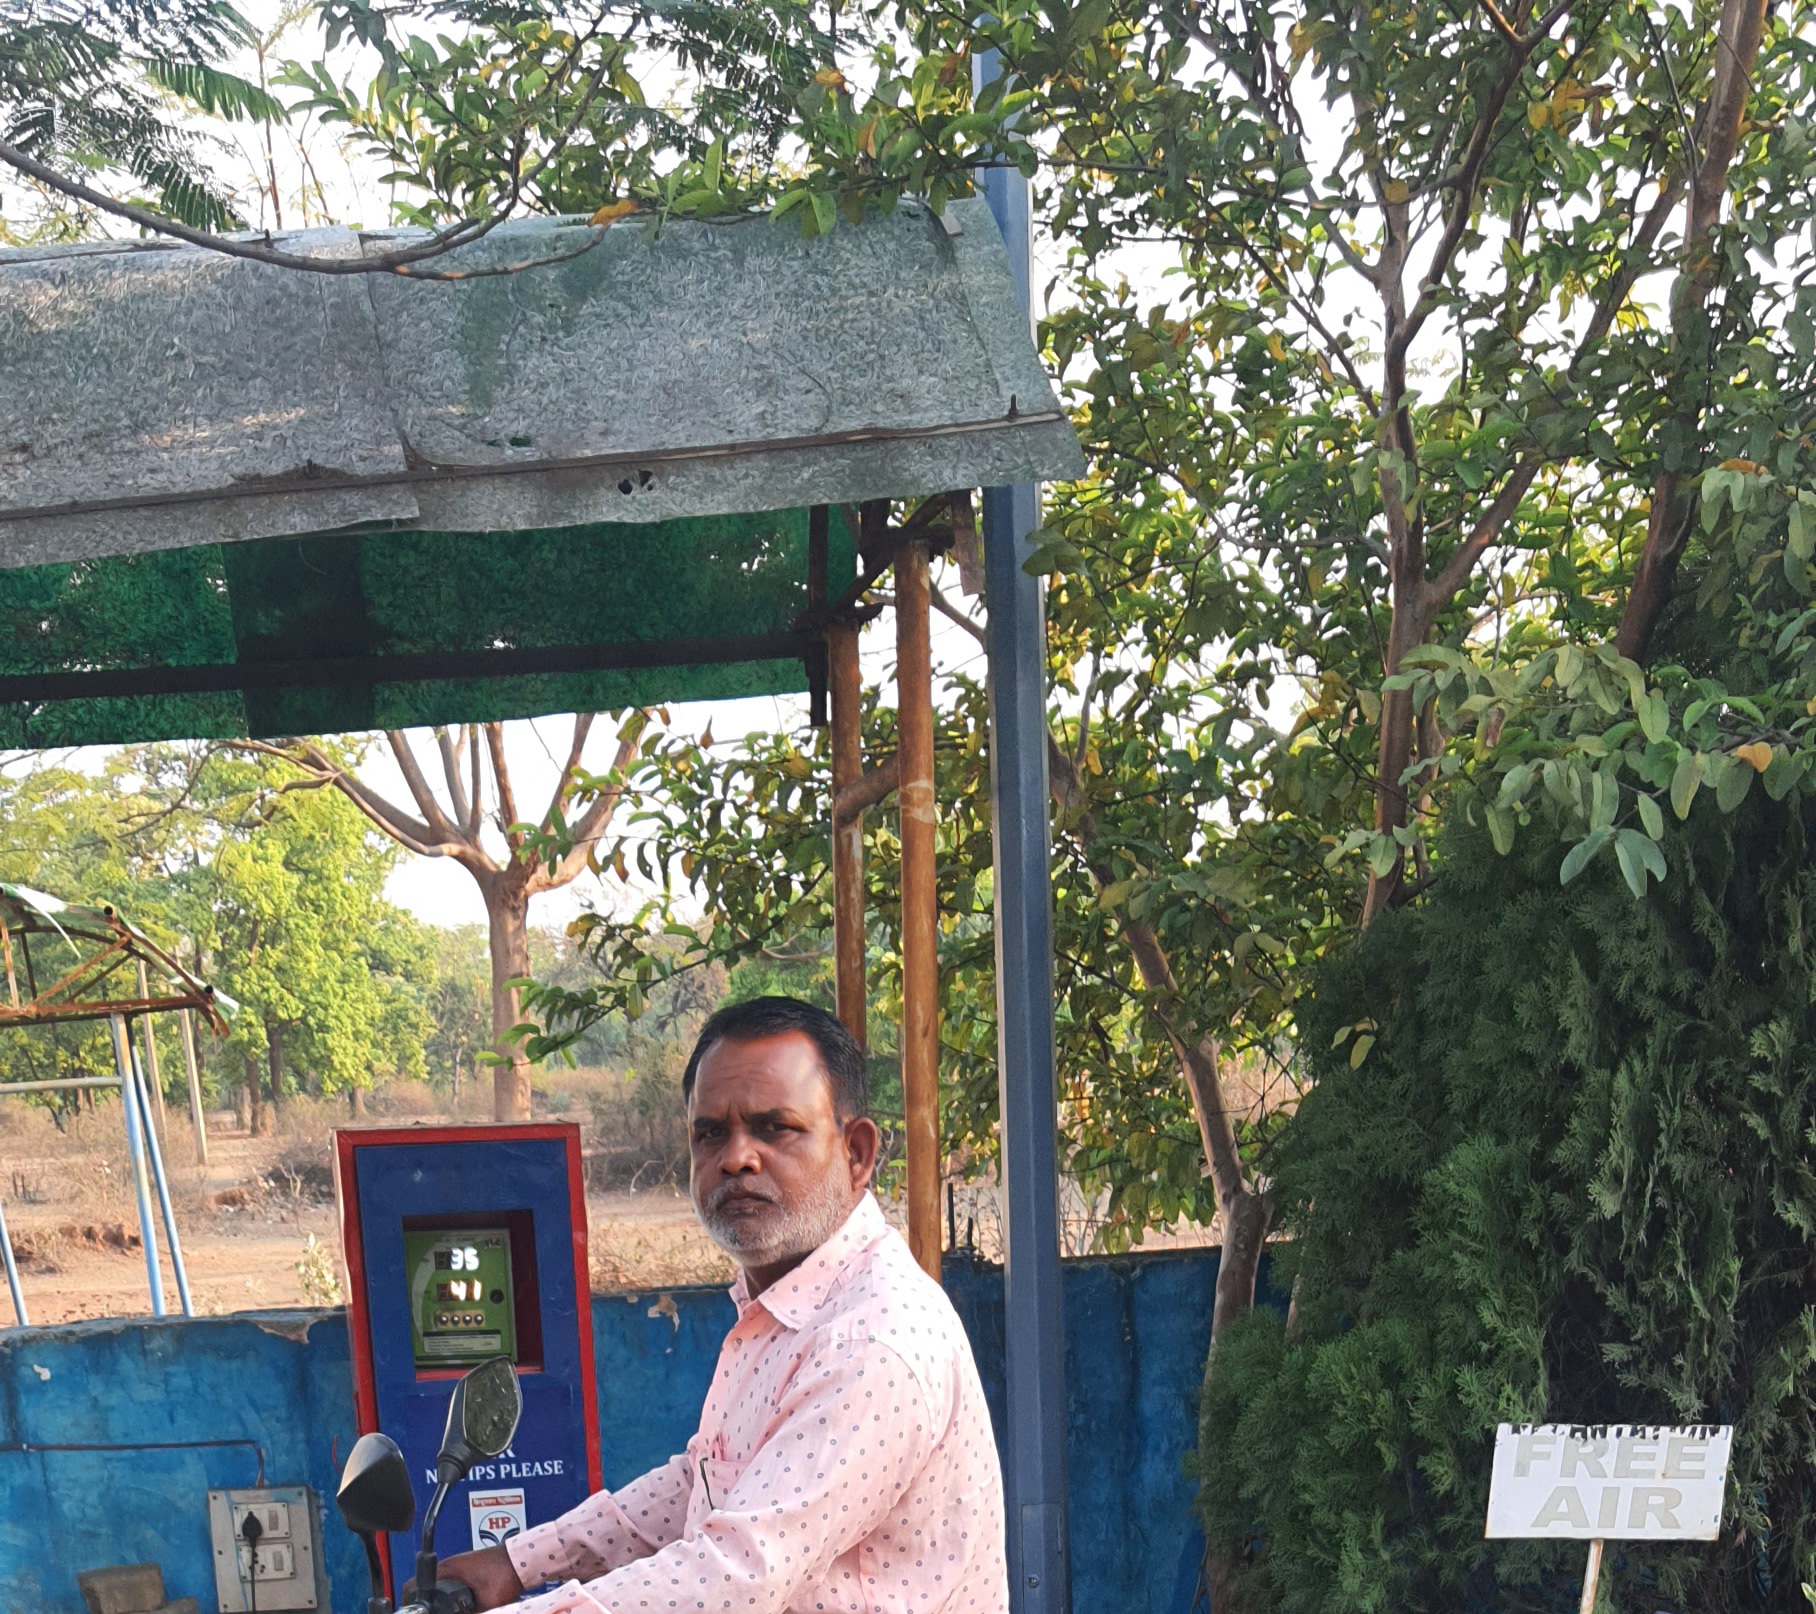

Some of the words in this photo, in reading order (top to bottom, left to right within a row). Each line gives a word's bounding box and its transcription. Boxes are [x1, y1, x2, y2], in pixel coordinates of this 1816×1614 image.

[459, 1464, 497, 1482] IPS
[500, 1459, 564, 1479] PLEASE
[1513, 1435, 1710, 1480] FREE
[488, 1516, 512, 1530] HP
[1530, 1485, 1684, 1529] AIR
